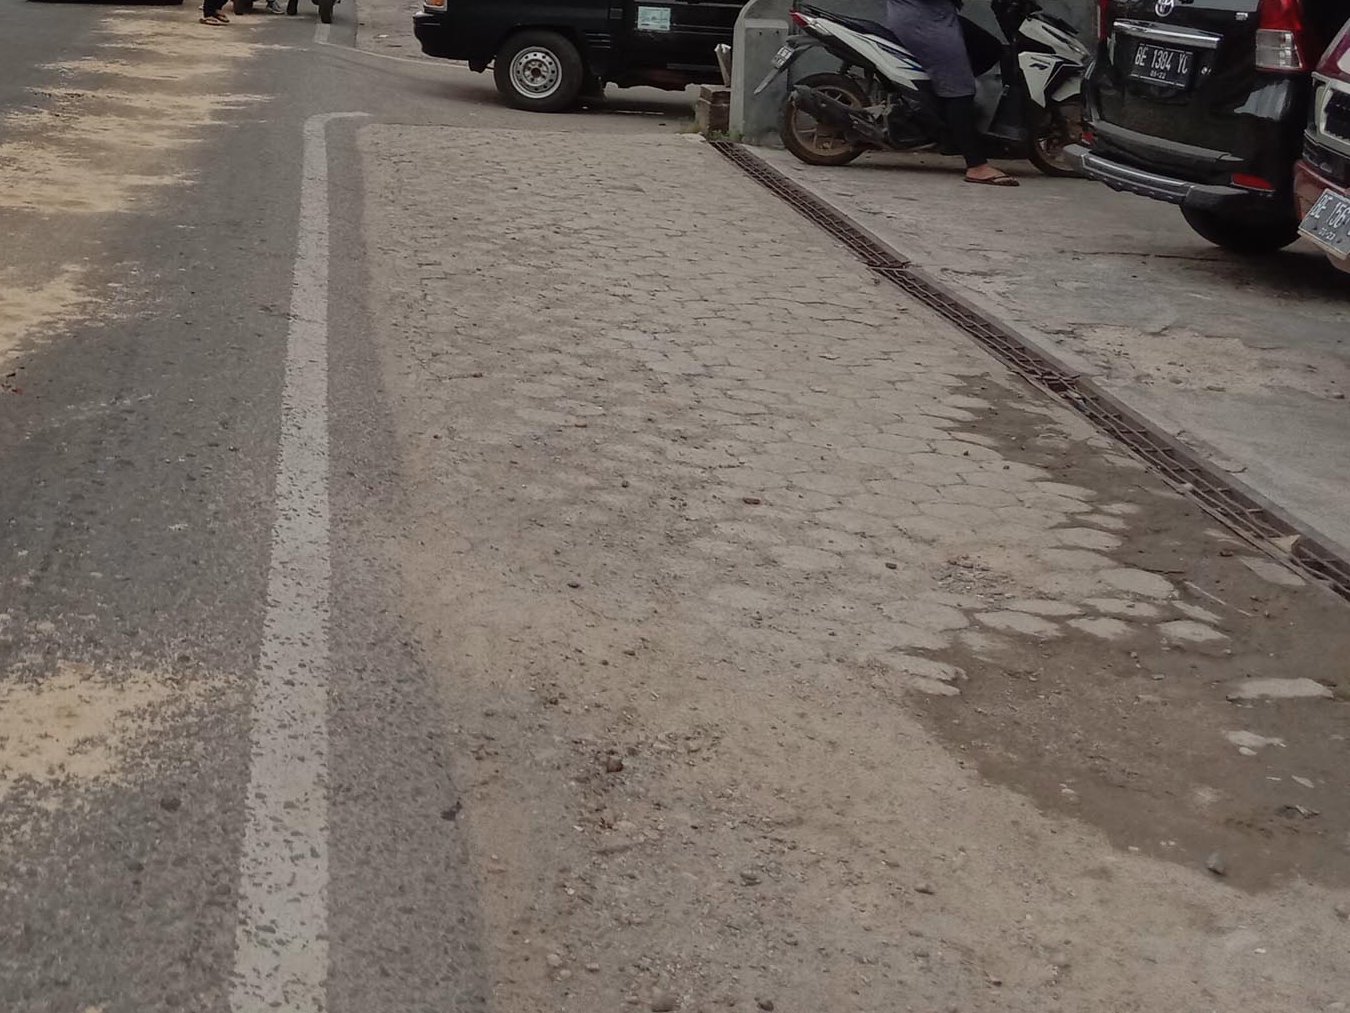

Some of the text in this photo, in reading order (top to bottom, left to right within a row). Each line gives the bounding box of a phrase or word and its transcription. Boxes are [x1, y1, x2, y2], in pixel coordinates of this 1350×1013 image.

[1134, 46, 1149, 66] BE
[1151, 49, 1173, 71] 1384
[1310, 194, 1334, 219] BE
